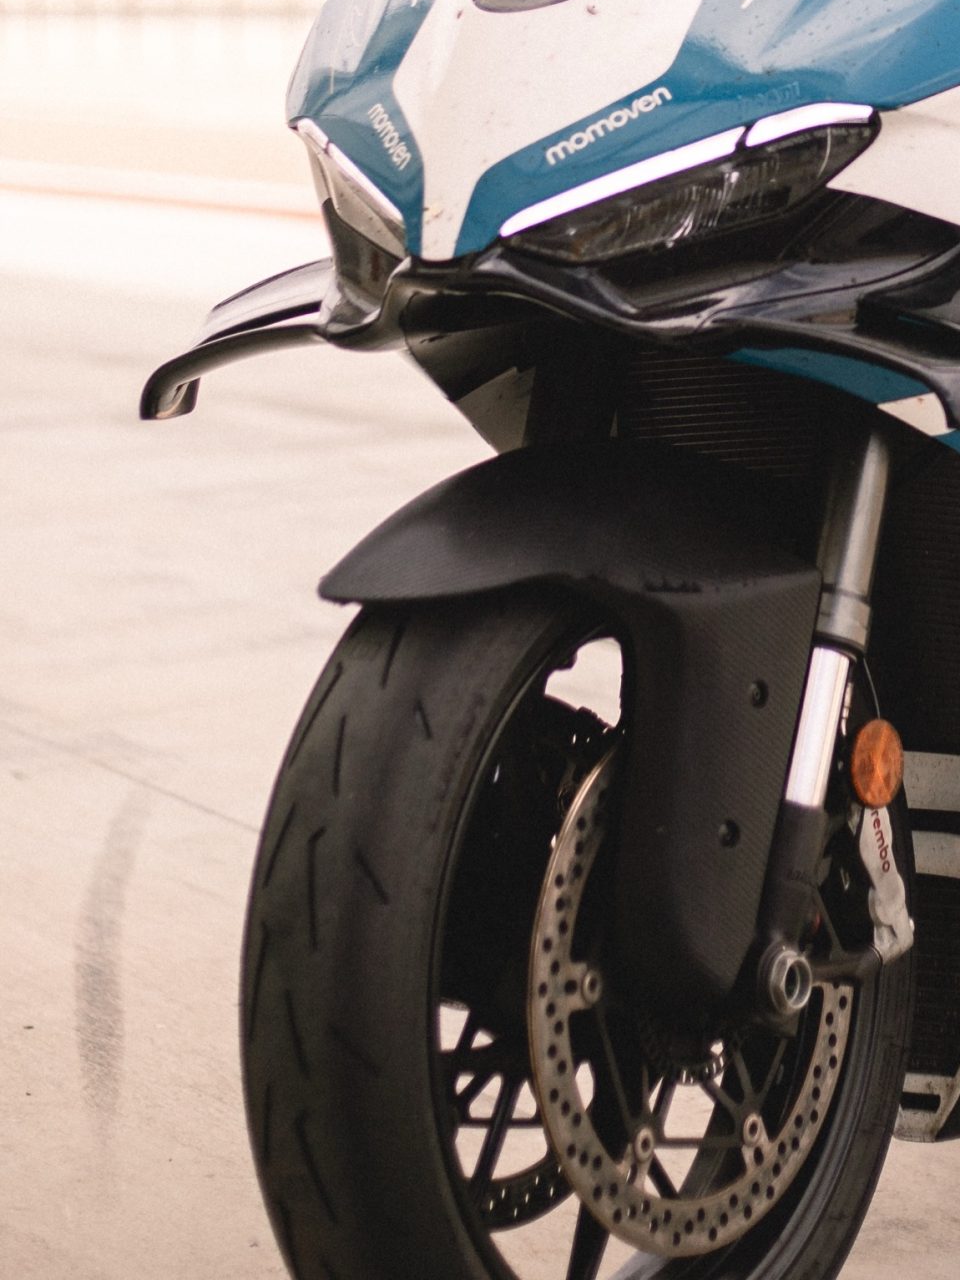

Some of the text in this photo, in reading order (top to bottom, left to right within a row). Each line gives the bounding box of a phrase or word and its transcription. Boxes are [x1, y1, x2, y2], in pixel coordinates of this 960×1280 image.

[367, 103, 412, 171] momoven
[545, 86, 673, 166] momoven
[870, 807, 890, 873] rembo
